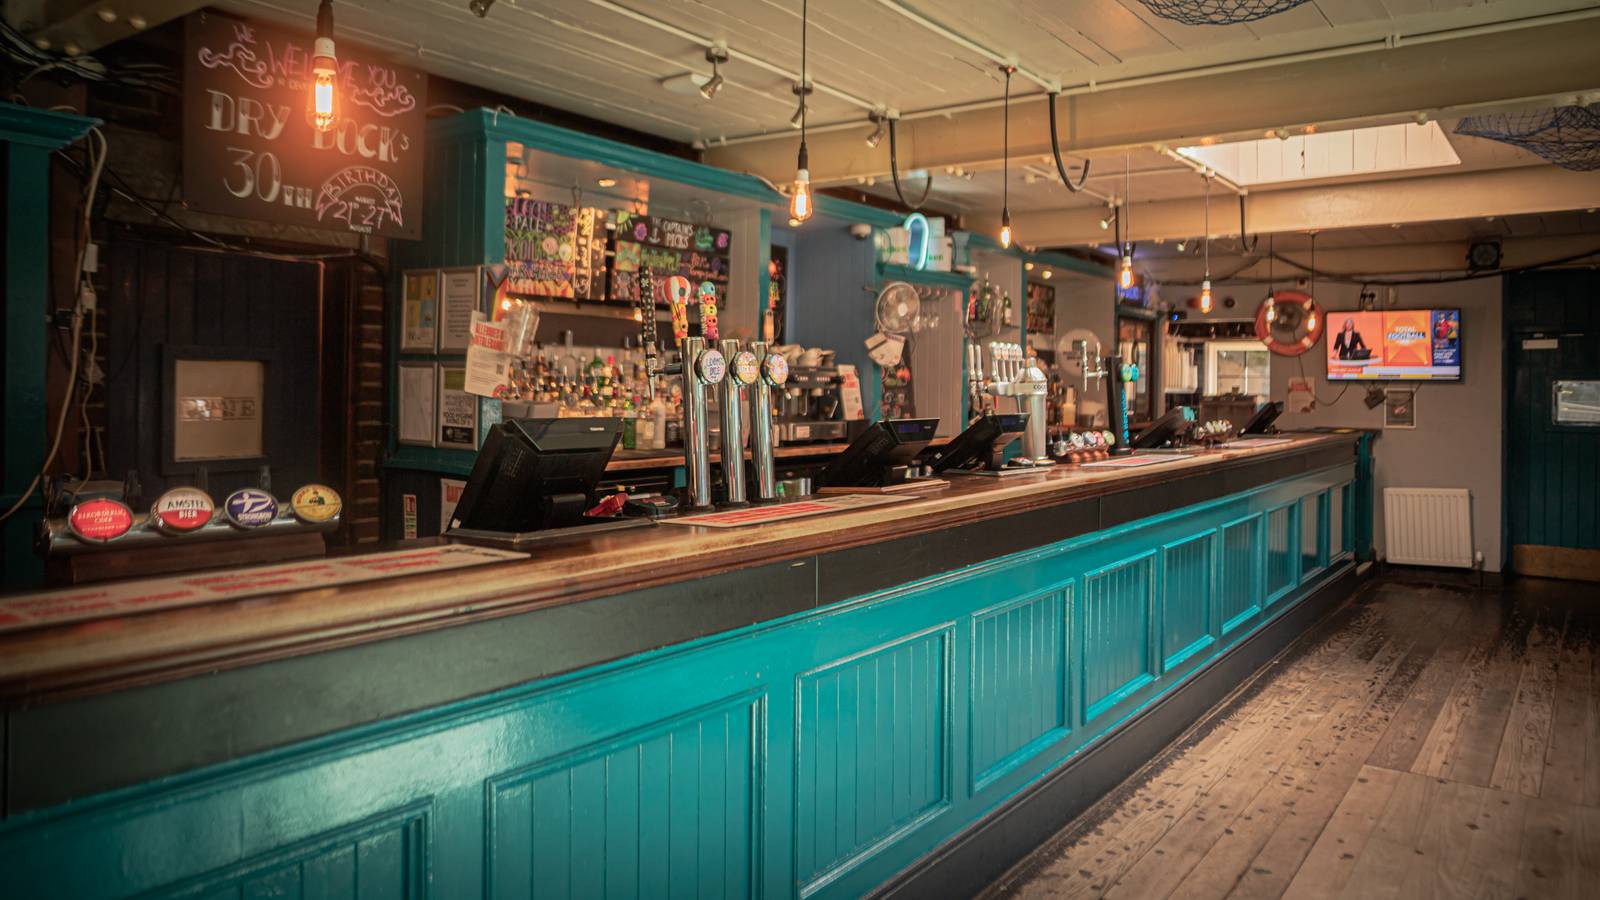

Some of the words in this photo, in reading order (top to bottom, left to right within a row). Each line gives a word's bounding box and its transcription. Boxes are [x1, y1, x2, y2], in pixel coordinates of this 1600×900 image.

[232, 24, 257, 45] WE
[265, 40, 360, 90] WELME
[368, 64, 397, 88] YOU
[205, 88, 291, 141] DRY
[664, 231, 690, 249] PICKS
[178, 508, 199, 520] BIER
